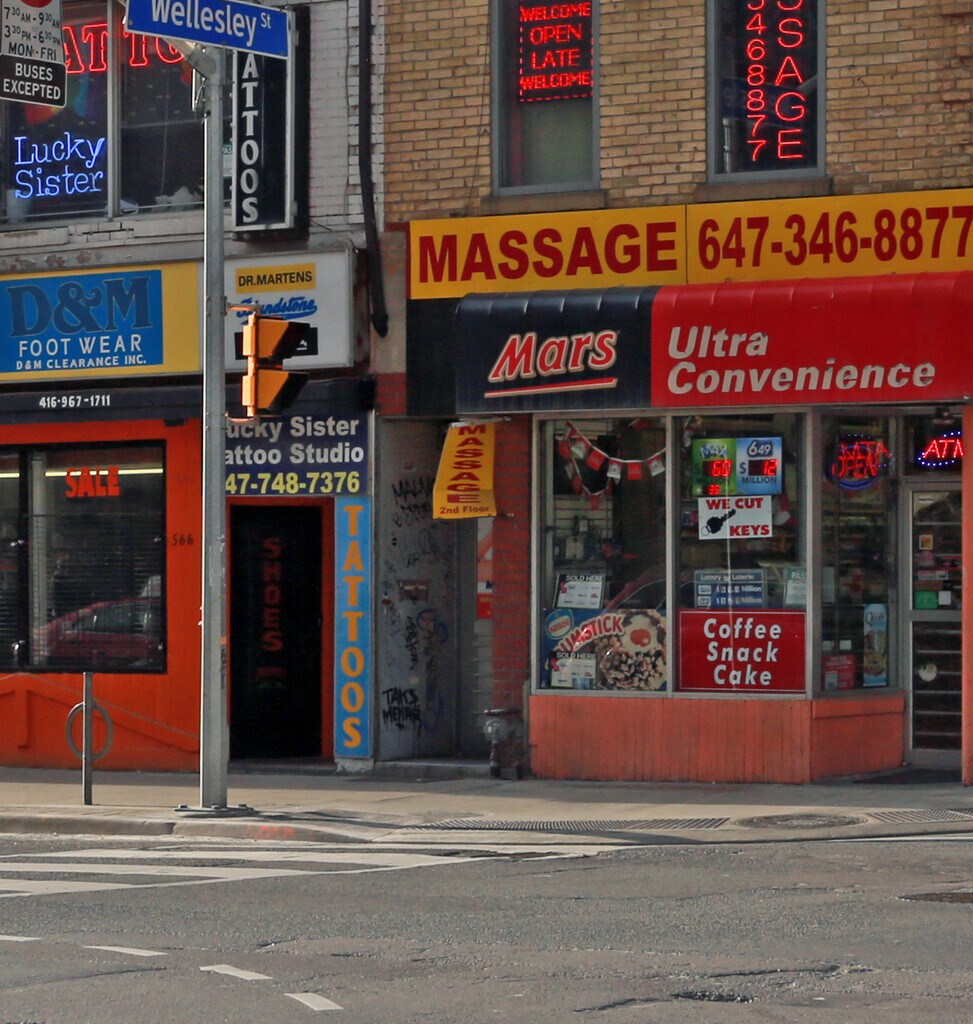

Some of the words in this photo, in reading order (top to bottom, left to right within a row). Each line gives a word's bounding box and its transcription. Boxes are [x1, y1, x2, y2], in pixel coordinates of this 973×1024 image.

[260, 12, 271, 29] St
[520, 2, 591, 21] WELCOME
[530, 23, 582, 45] OPEN
[531, 48, 581, 70] LATE
[15, 62, 53, 81] BUSES
[520, 70, 591, 90] WELCOME
[3, 78, 61, 100] EXCEPTED
[241, 53, 260, 223] ATTOOS
[14, 132, 105, 168] Lucky
[15, 167, 104, 199] Sister
[419, 222, 678, 283] MASSAGE
[239, 271, 312, 287] DR.MARTENS
[6, 277, 152, 337] D&M
[19, 338, 71, 358] FOOT
[79, 334, 142, 355] WEAR
[667, 326, 768, 359] Ultra
[16, 360, 42, 370] D&M
[47, 355, 119, 368] CLEARANCE
[124, 354, 147, 365] INC.
[488, 332, 617, 381] Mars
[667, 358, 936, 394] Convenience
[226, 418, 282, 442] ucky
[290, 416, 359, 437] Sister
[225, 445, 282, 465] attoo
[290, 442, 364, 463] Studio
[447, 425, 484, 504] MASSAGE
[66, 466, 120, 497] SALE
[225, 472, 360, 494] 47-748-7376
[706, 499, 730, 510] WE
[735, 498, 763, 509] CUT
[172, 534, 194, 546] 566
[730, 525, 769, 536] KEYS
[263, 537, 284, 651] SHOES
[341, 505, 365, 748] TATTOOS
[703, 617, 782, 639] Coffee
[706, 641, 779, 662] Snack
[713, 664, 772, 685] Cake
